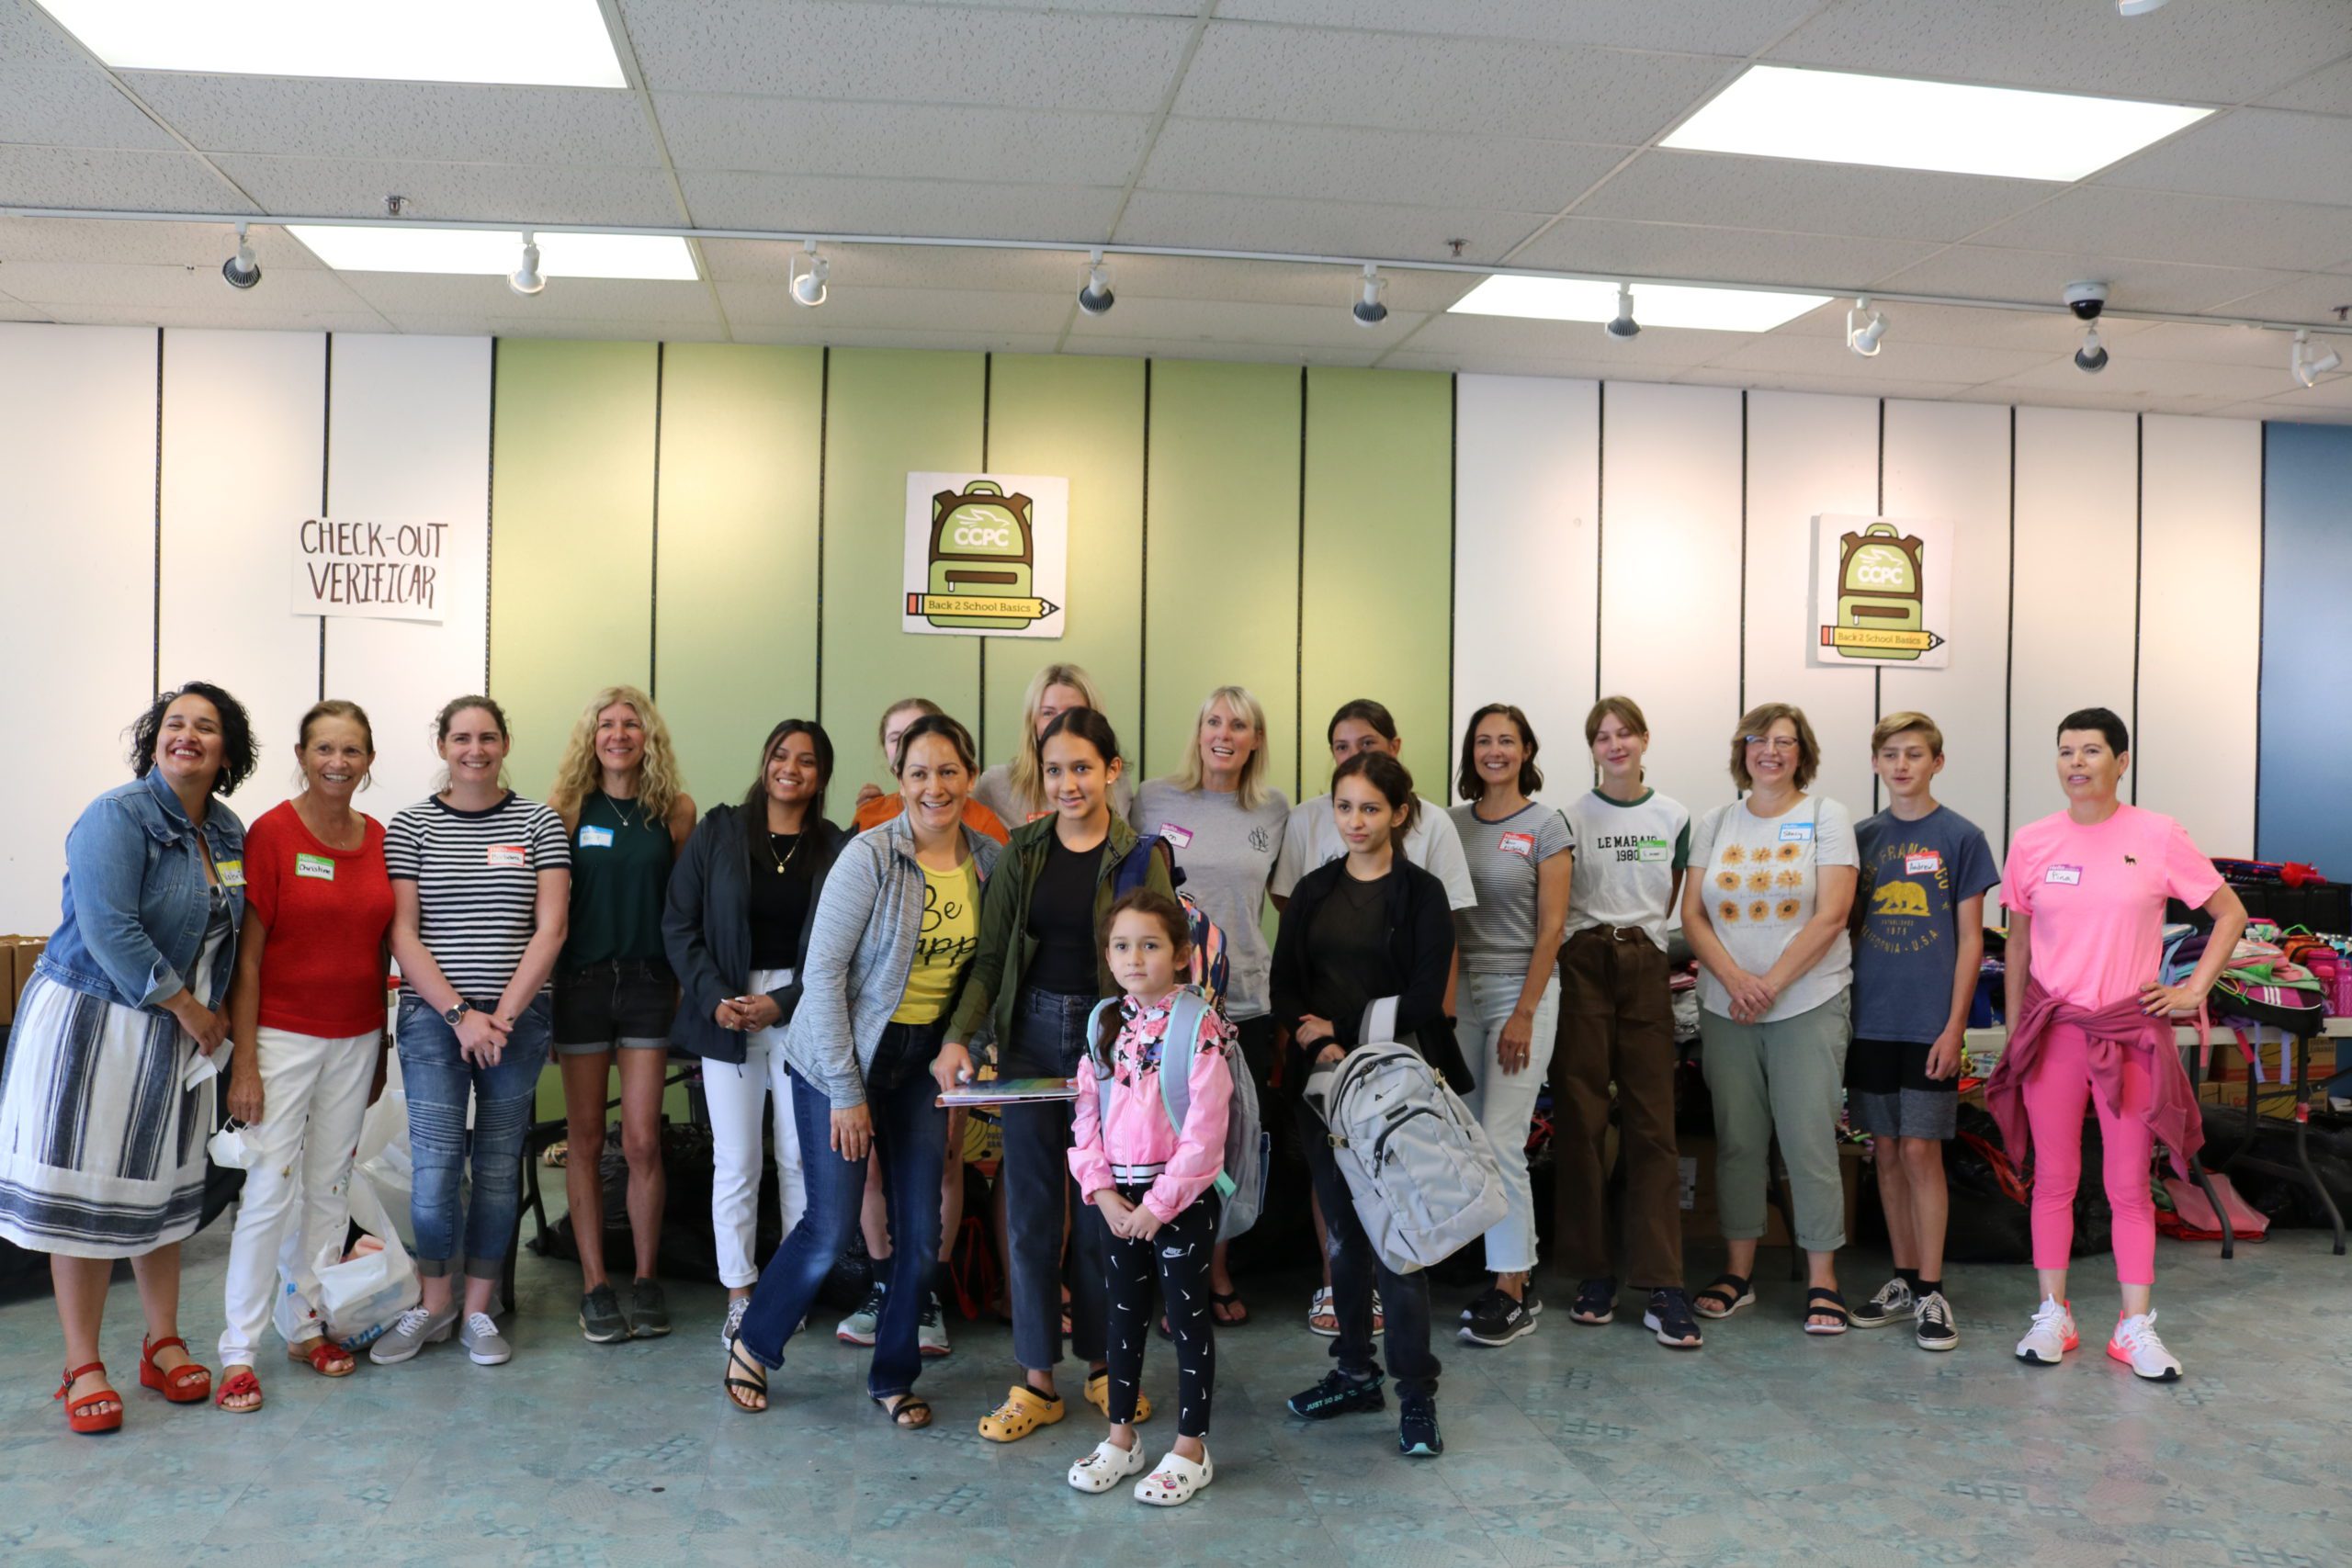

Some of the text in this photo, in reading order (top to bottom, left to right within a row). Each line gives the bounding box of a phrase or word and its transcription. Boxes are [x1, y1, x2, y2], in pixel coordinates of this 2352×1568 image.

[300, 520, 448, 558] CHECK-OUT
[955, 527, 1010, 547] CCPC
[1858, 565, 1903, 585] CCPC
[307, 561, 436, 609] VERIFICAR
[928, 600, 1031, 613] Back 2 School Basics
[1838, 632, 1921, 644] Back 2 School Basics
[1597, 837, 1611, 849] LE
[1616, 850, 1640, 862] 1980
[1909, 862, 1934, 872] Andrew
[921, 884, 963, 933] Be
[916, 935, 979, 968] app
[1306, 1400, 1324, 1412] JUST
